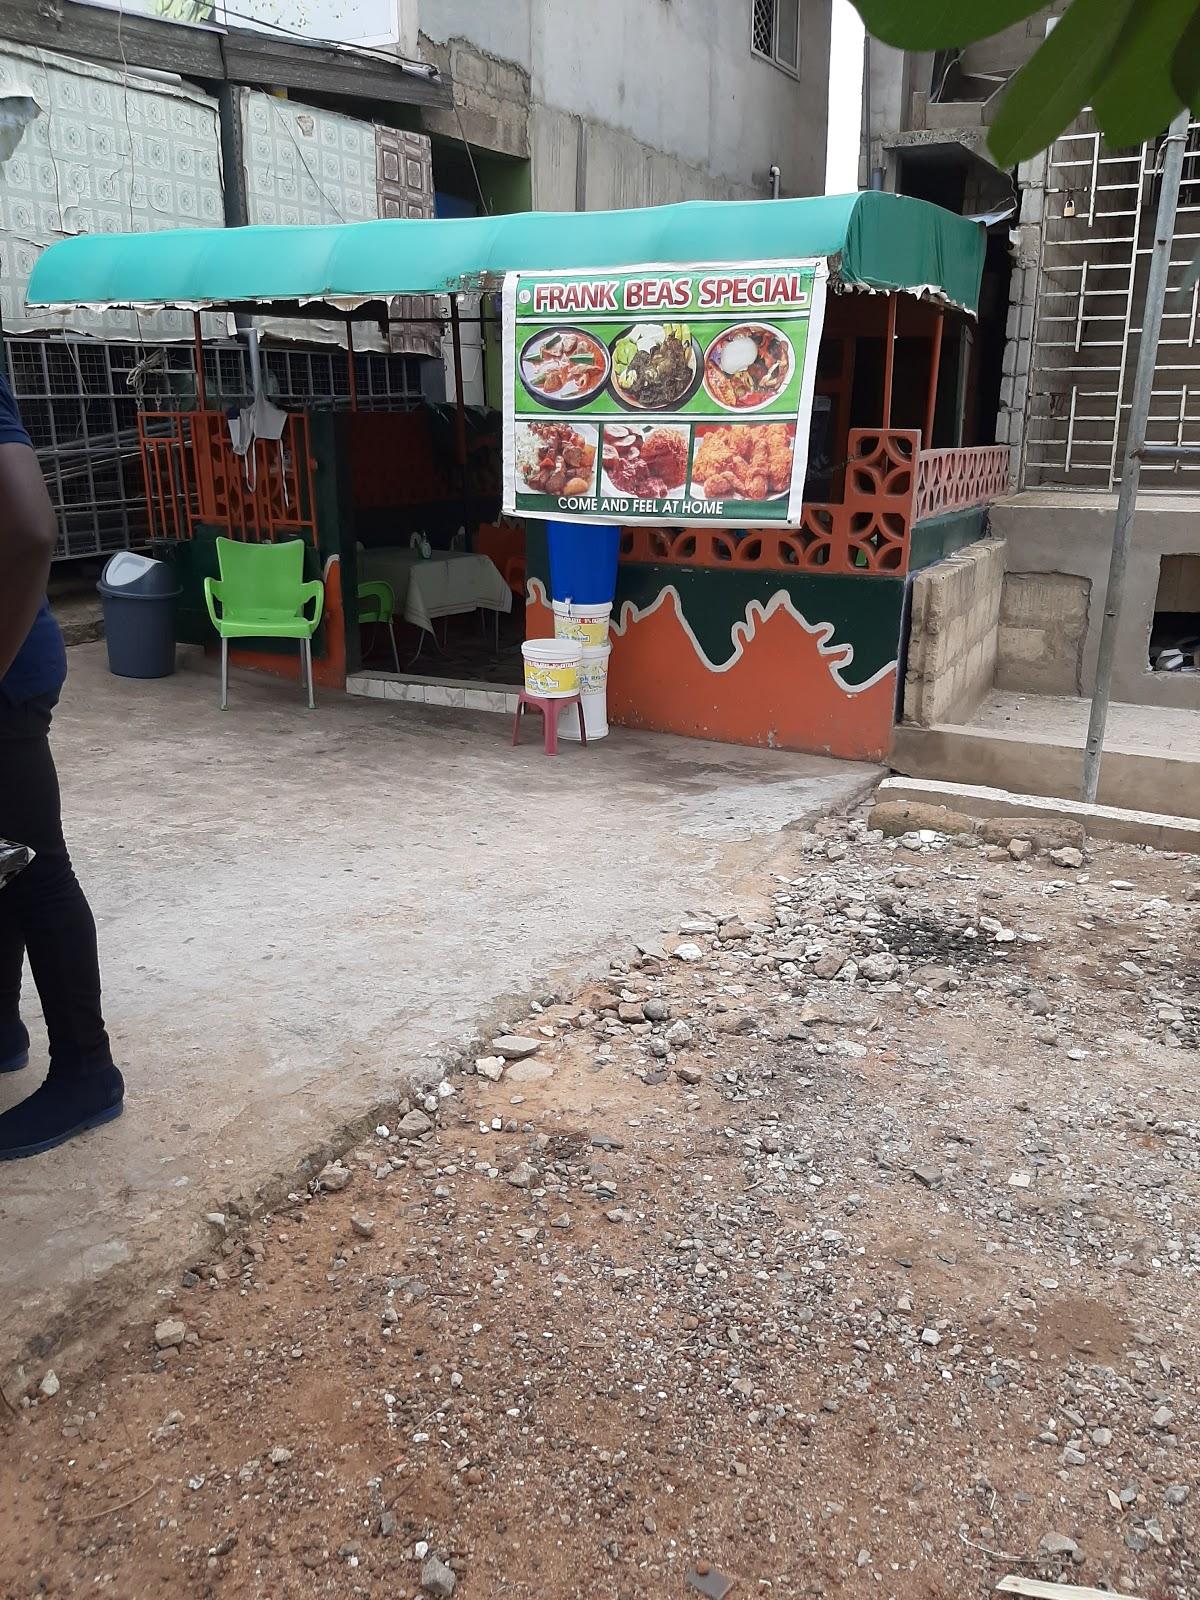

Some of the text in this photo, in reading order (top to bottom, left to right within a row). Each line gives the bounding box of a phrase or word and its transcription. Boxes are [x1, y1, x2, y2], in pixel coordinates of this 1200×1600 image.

[535, 283, 618, 310] FRANK
[626, 280, 691, 308] BEAS
[700, 277, 805, 305] SPECIAL
[558, 497, 724, 515] COME AND FEEL AT HOME
